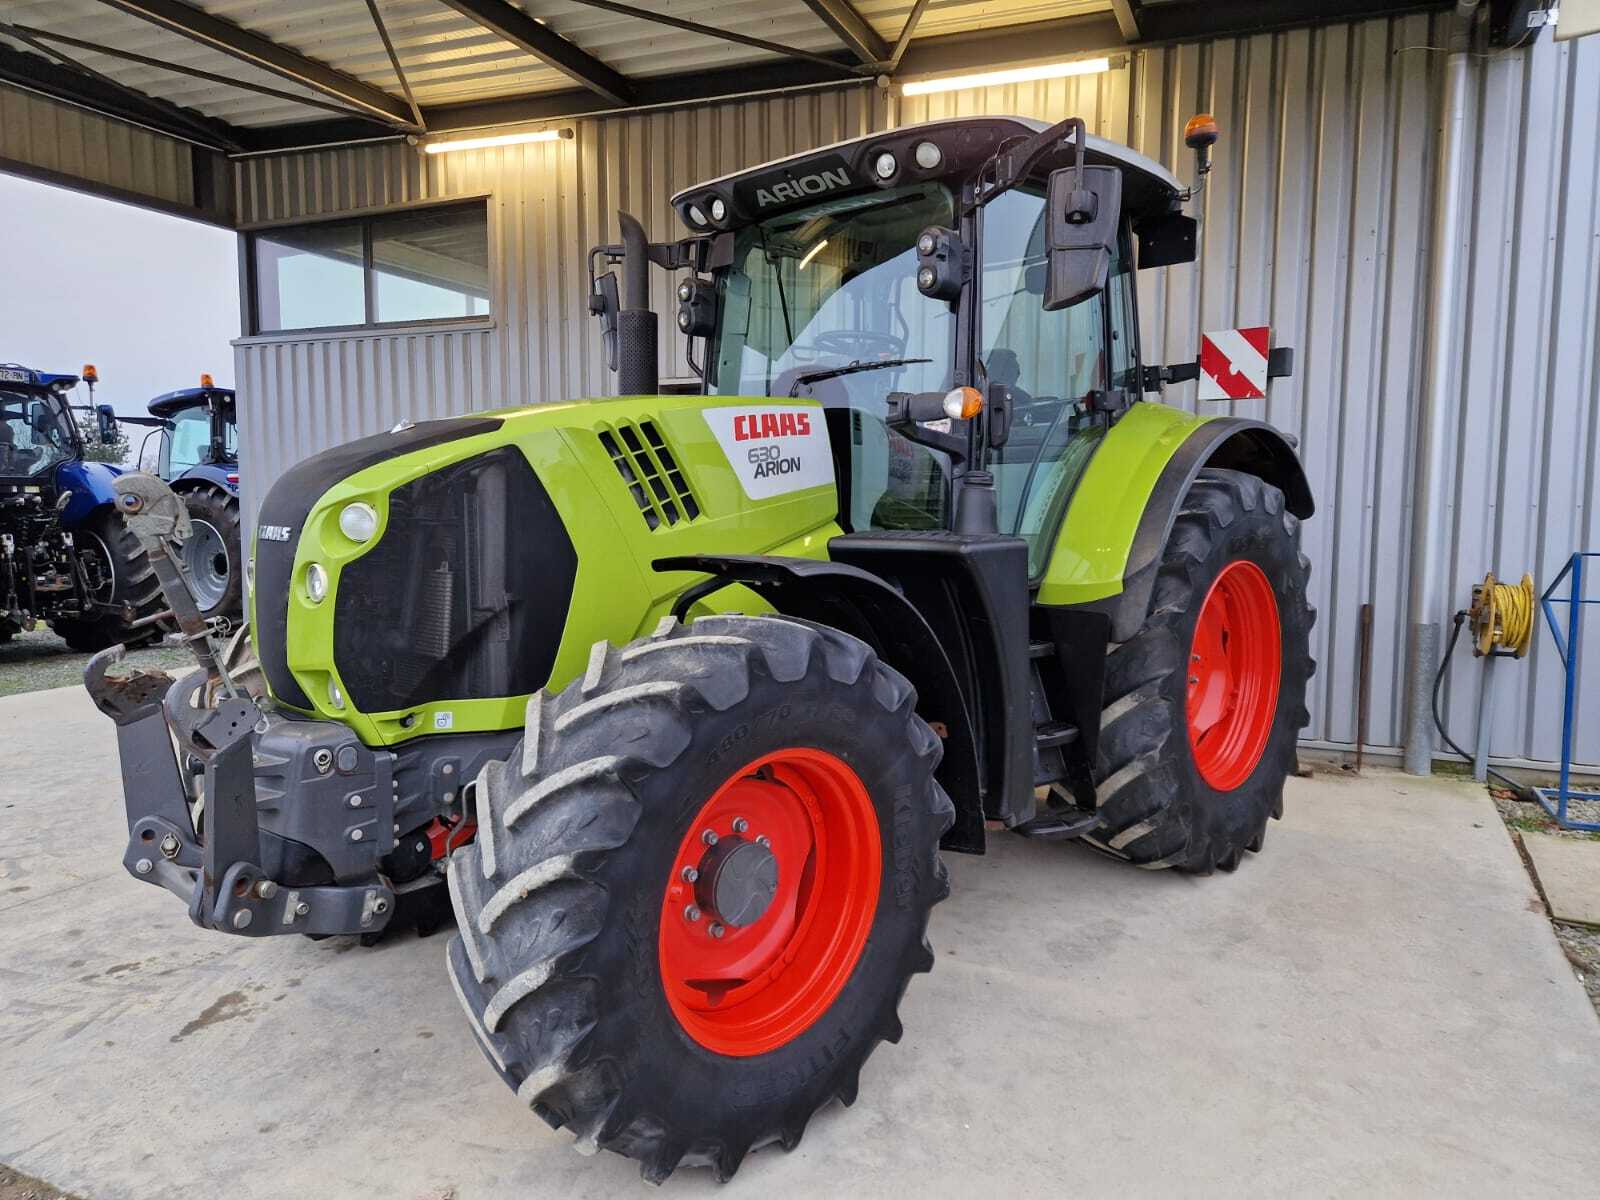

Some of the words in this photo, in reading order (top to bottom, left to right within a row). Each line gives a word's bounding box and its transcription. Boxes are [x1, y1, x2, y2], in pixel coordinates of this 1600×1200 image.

[756, 167, 851, 207] ARION
[734, 413, 811, 441] CLAAS
[748, 445, 781, 464] 630
[754, 456, 801, 479] ARION
